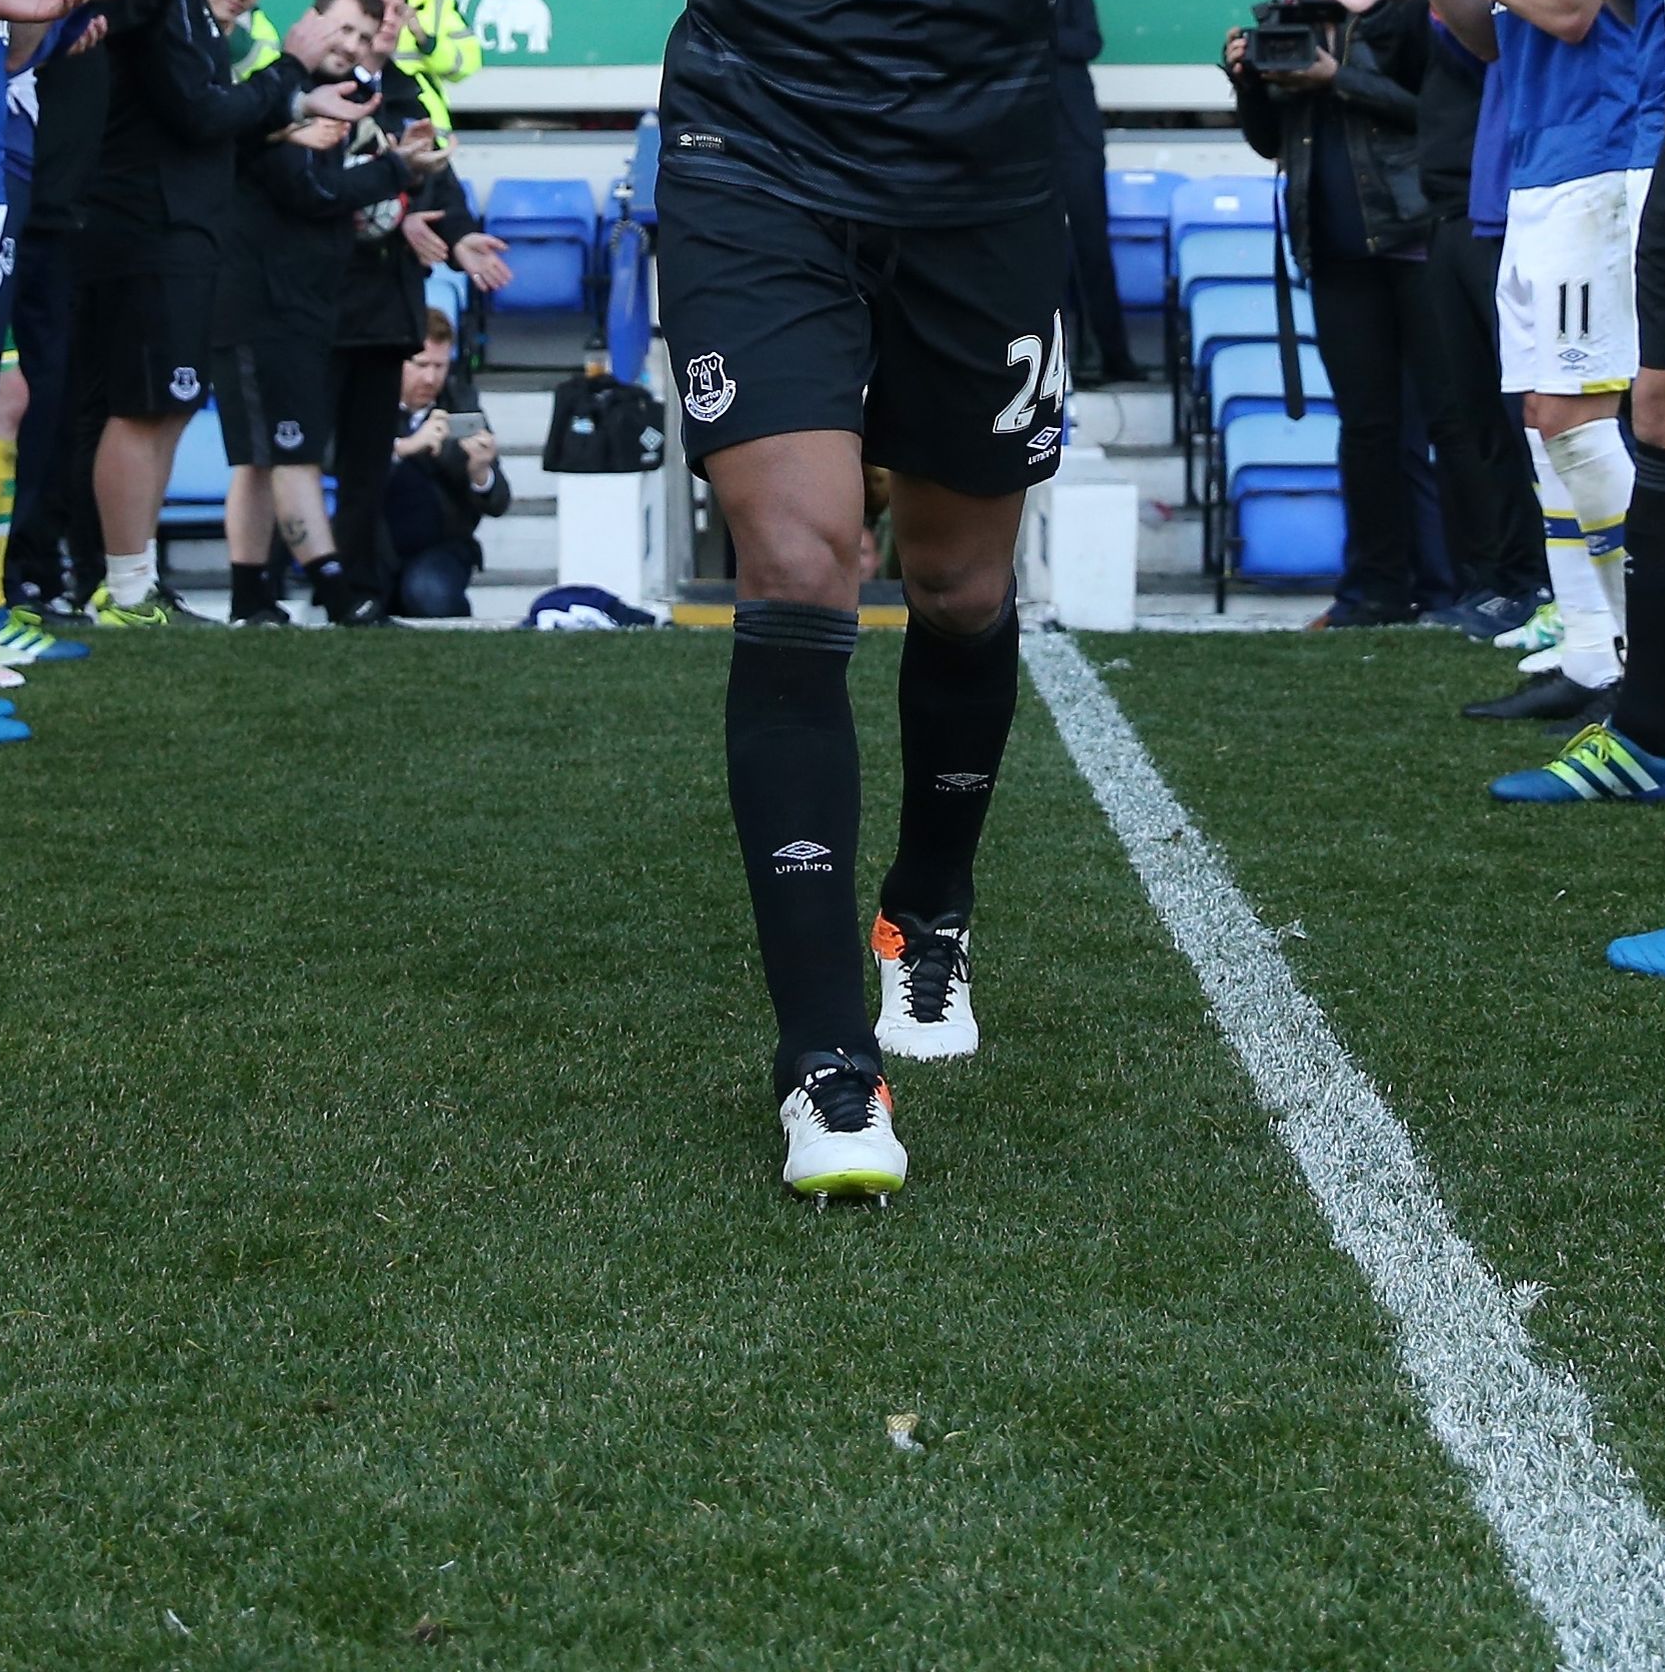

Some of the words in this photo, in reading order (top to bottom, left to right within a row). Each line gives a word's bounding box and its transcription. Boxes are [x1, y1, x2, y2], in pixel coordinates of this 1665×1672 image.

[1555, 279, 1592, 343] 11
[992, 308, 1067, 434] 24
[775, 860, 833, 875] umbro
